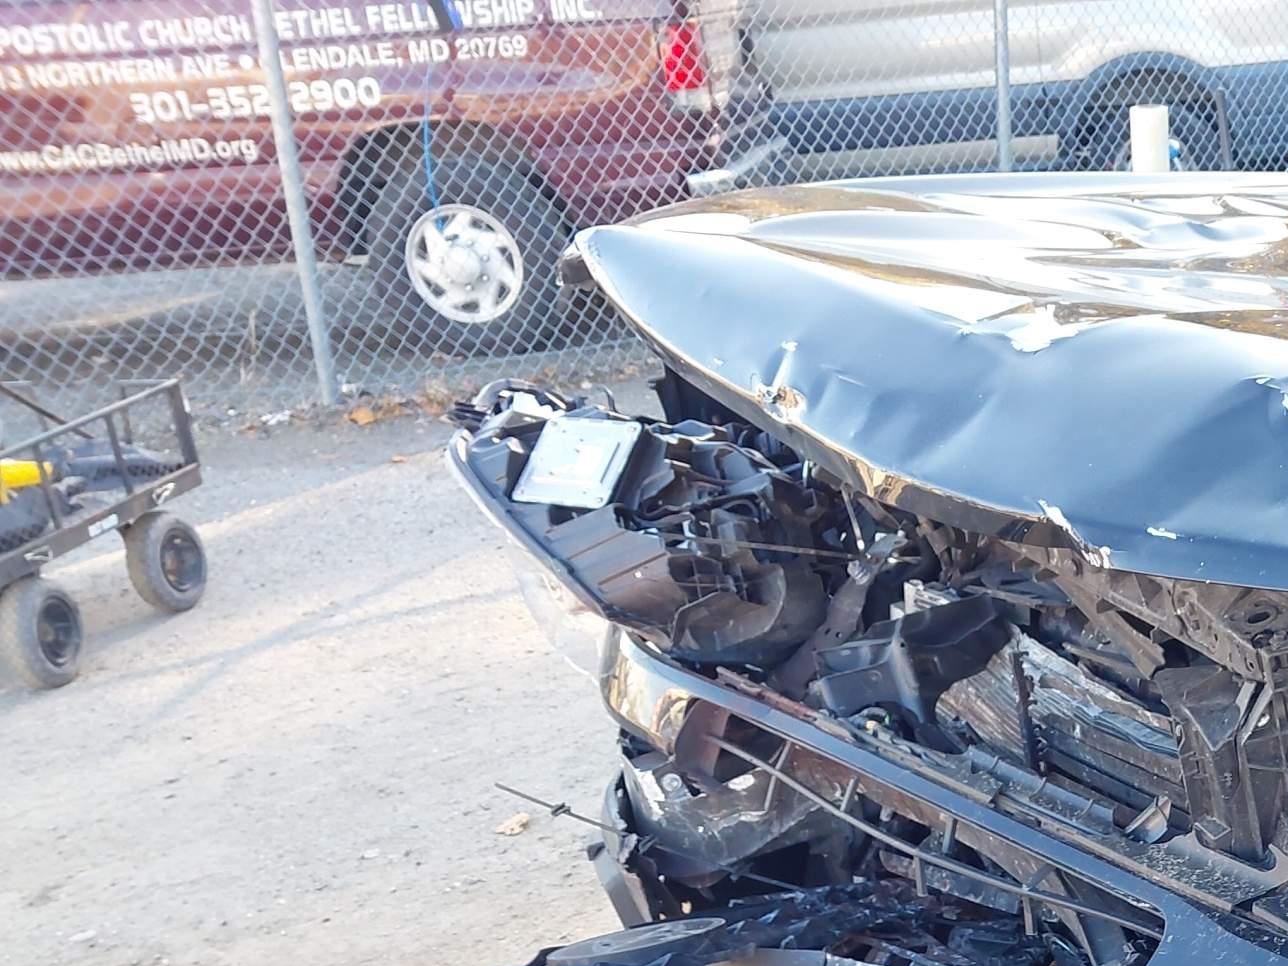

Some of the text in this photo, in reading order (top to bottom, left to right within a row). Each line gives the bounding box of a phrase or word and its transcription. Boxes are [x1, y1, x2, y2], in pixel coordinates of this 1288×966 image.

[138, 15, 251, 47] CHURCH
[272, 8, 361, 39] ETHEL
[550, 0, 603, 20] INC.
[26, 56, 176, 89] NORTHERN
[264, 42, 403, 72] LENDALE,
[408, 38, 450, 63] MD
[456, 34, 529, 60] 20769
